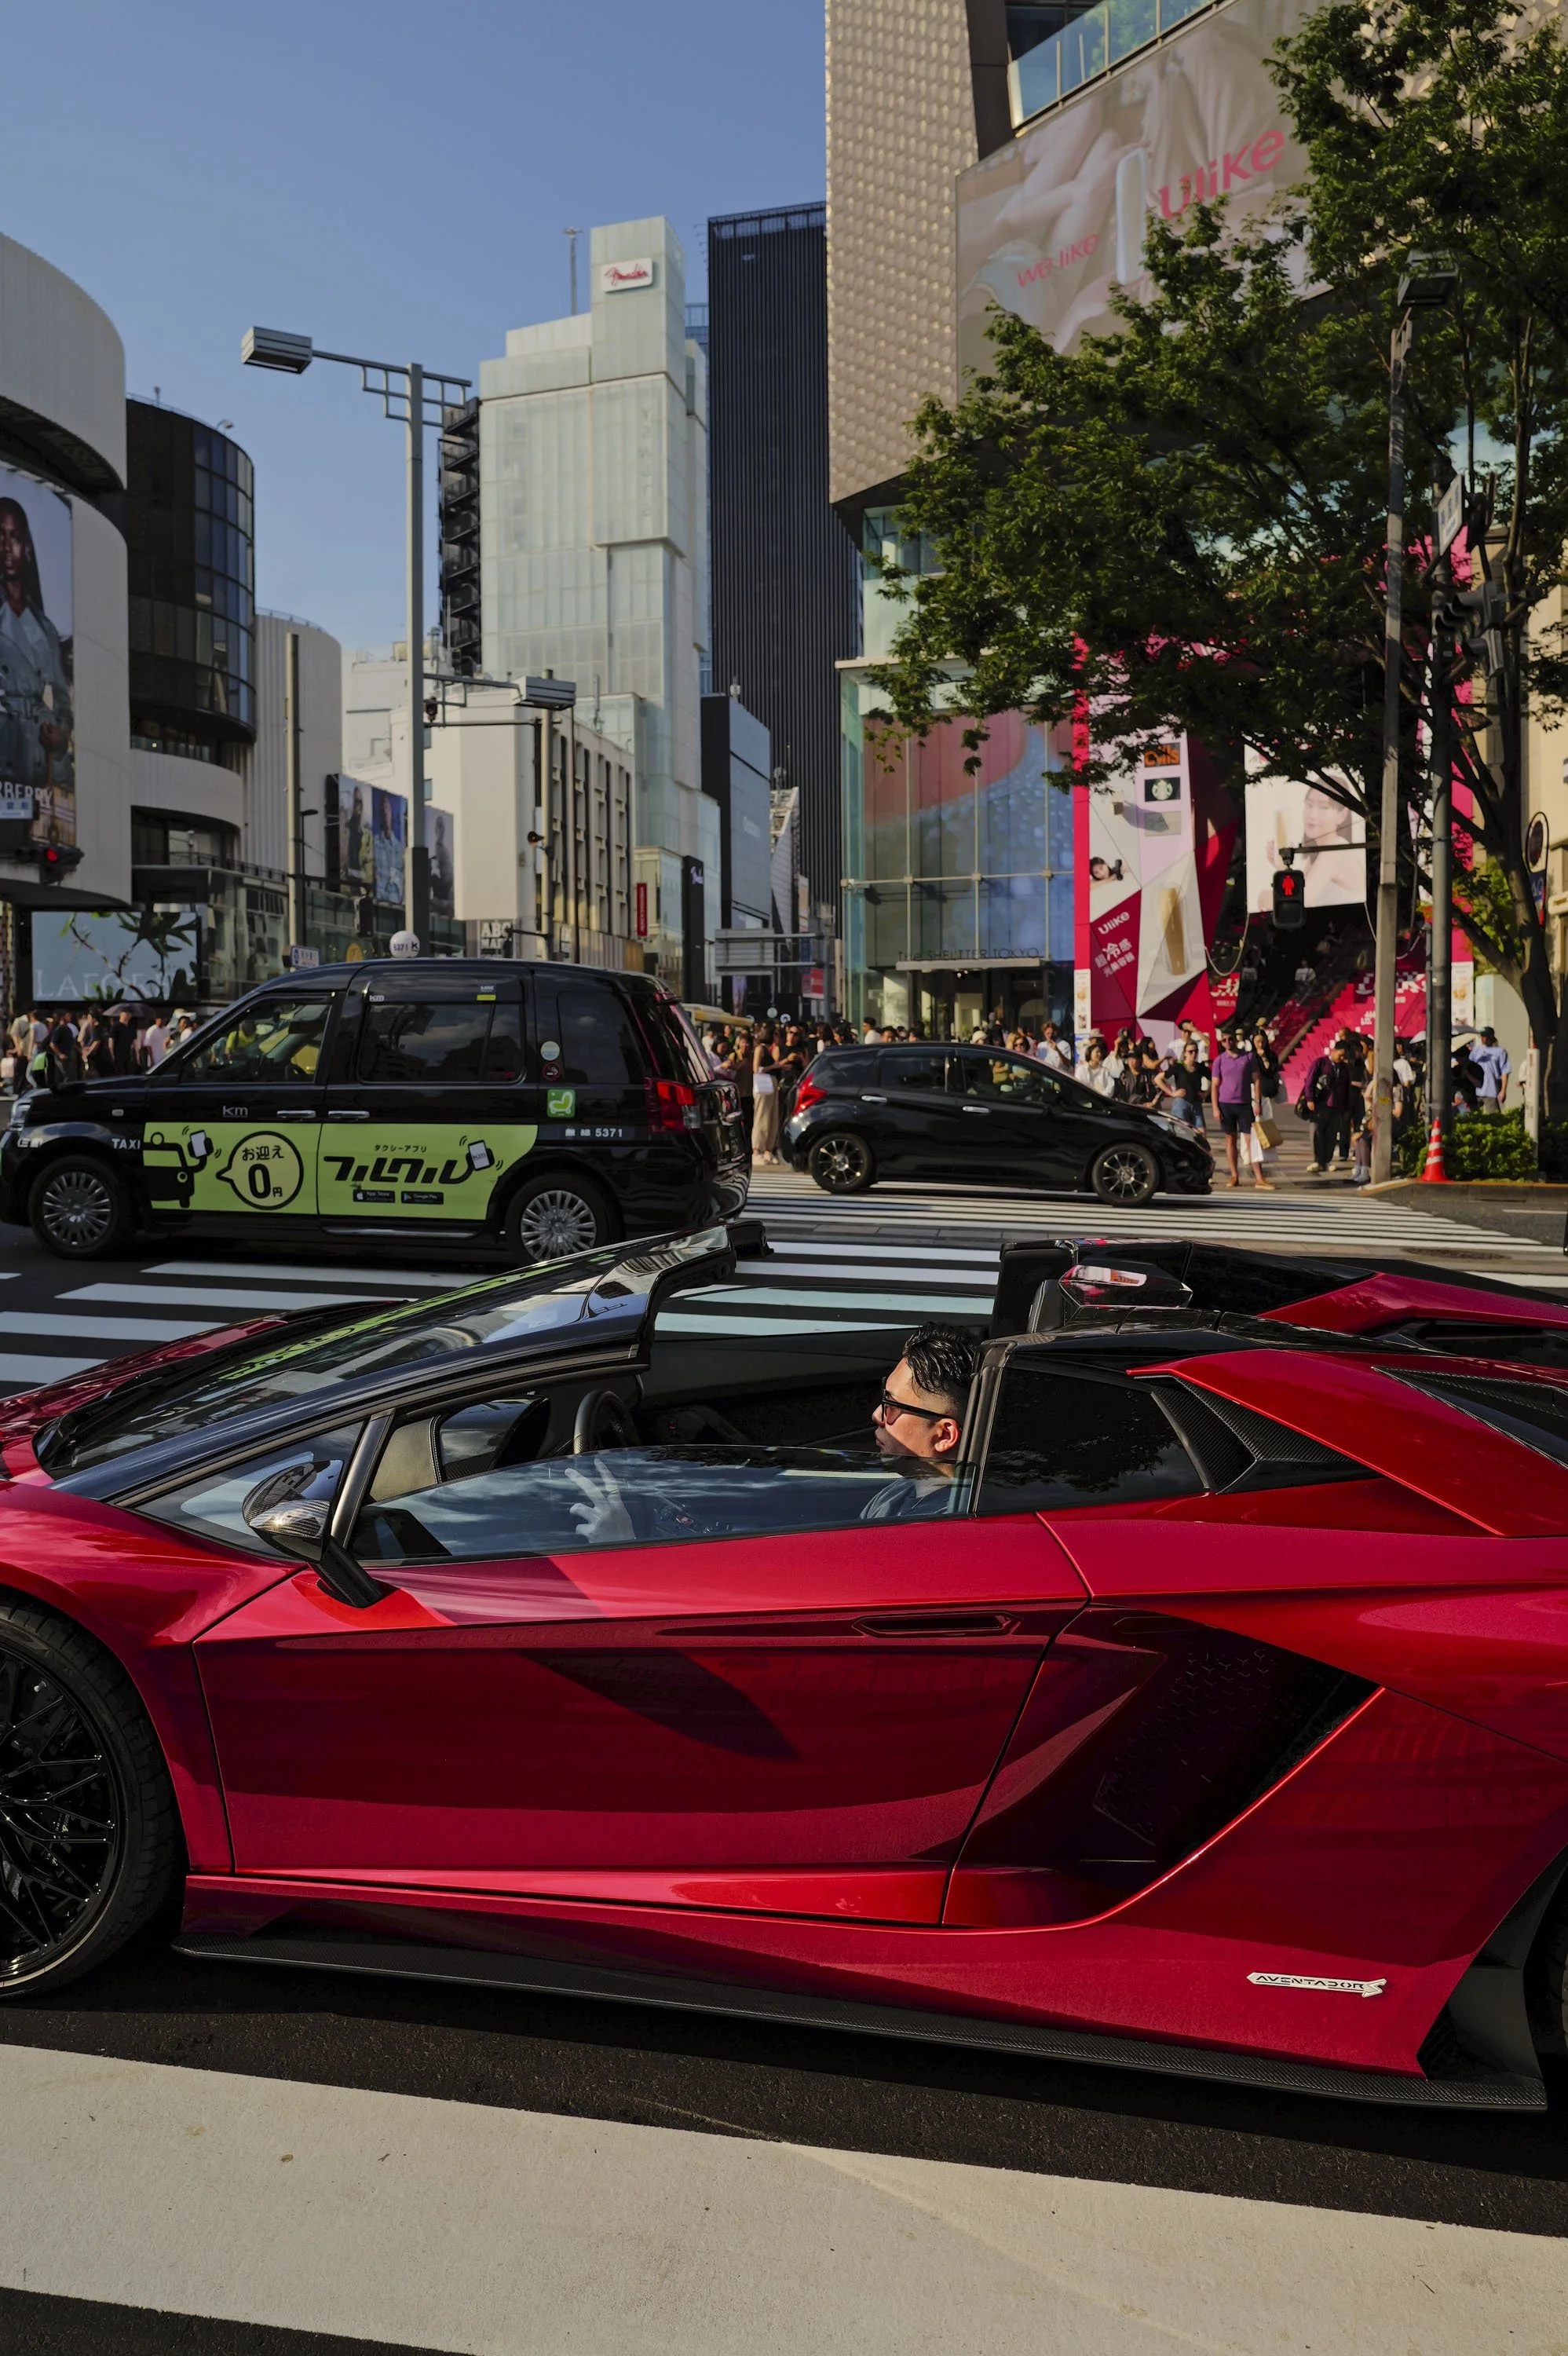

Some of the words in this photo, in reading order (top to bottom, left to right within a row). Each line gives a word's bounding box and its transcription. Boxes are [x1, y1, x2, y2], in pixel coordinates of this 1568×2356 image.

[1018, 258, 1053, 287] we
[1058, 233, 1100, 271] like
[993, 947, 1040, 958] TOKYO
[223, 1106, 248, 1117] km
[595, 1128, 623, 1137] 5371
[111, 1138, 141, 1151] TAXI
[375, 1144, 427, 1153] タクシーアプリ
[242, 1145, 284, 1162] お迎え
[248, 1163, 283, 1199] 0円
[1256, 1975, 1365, 1987] AVENTADOR
